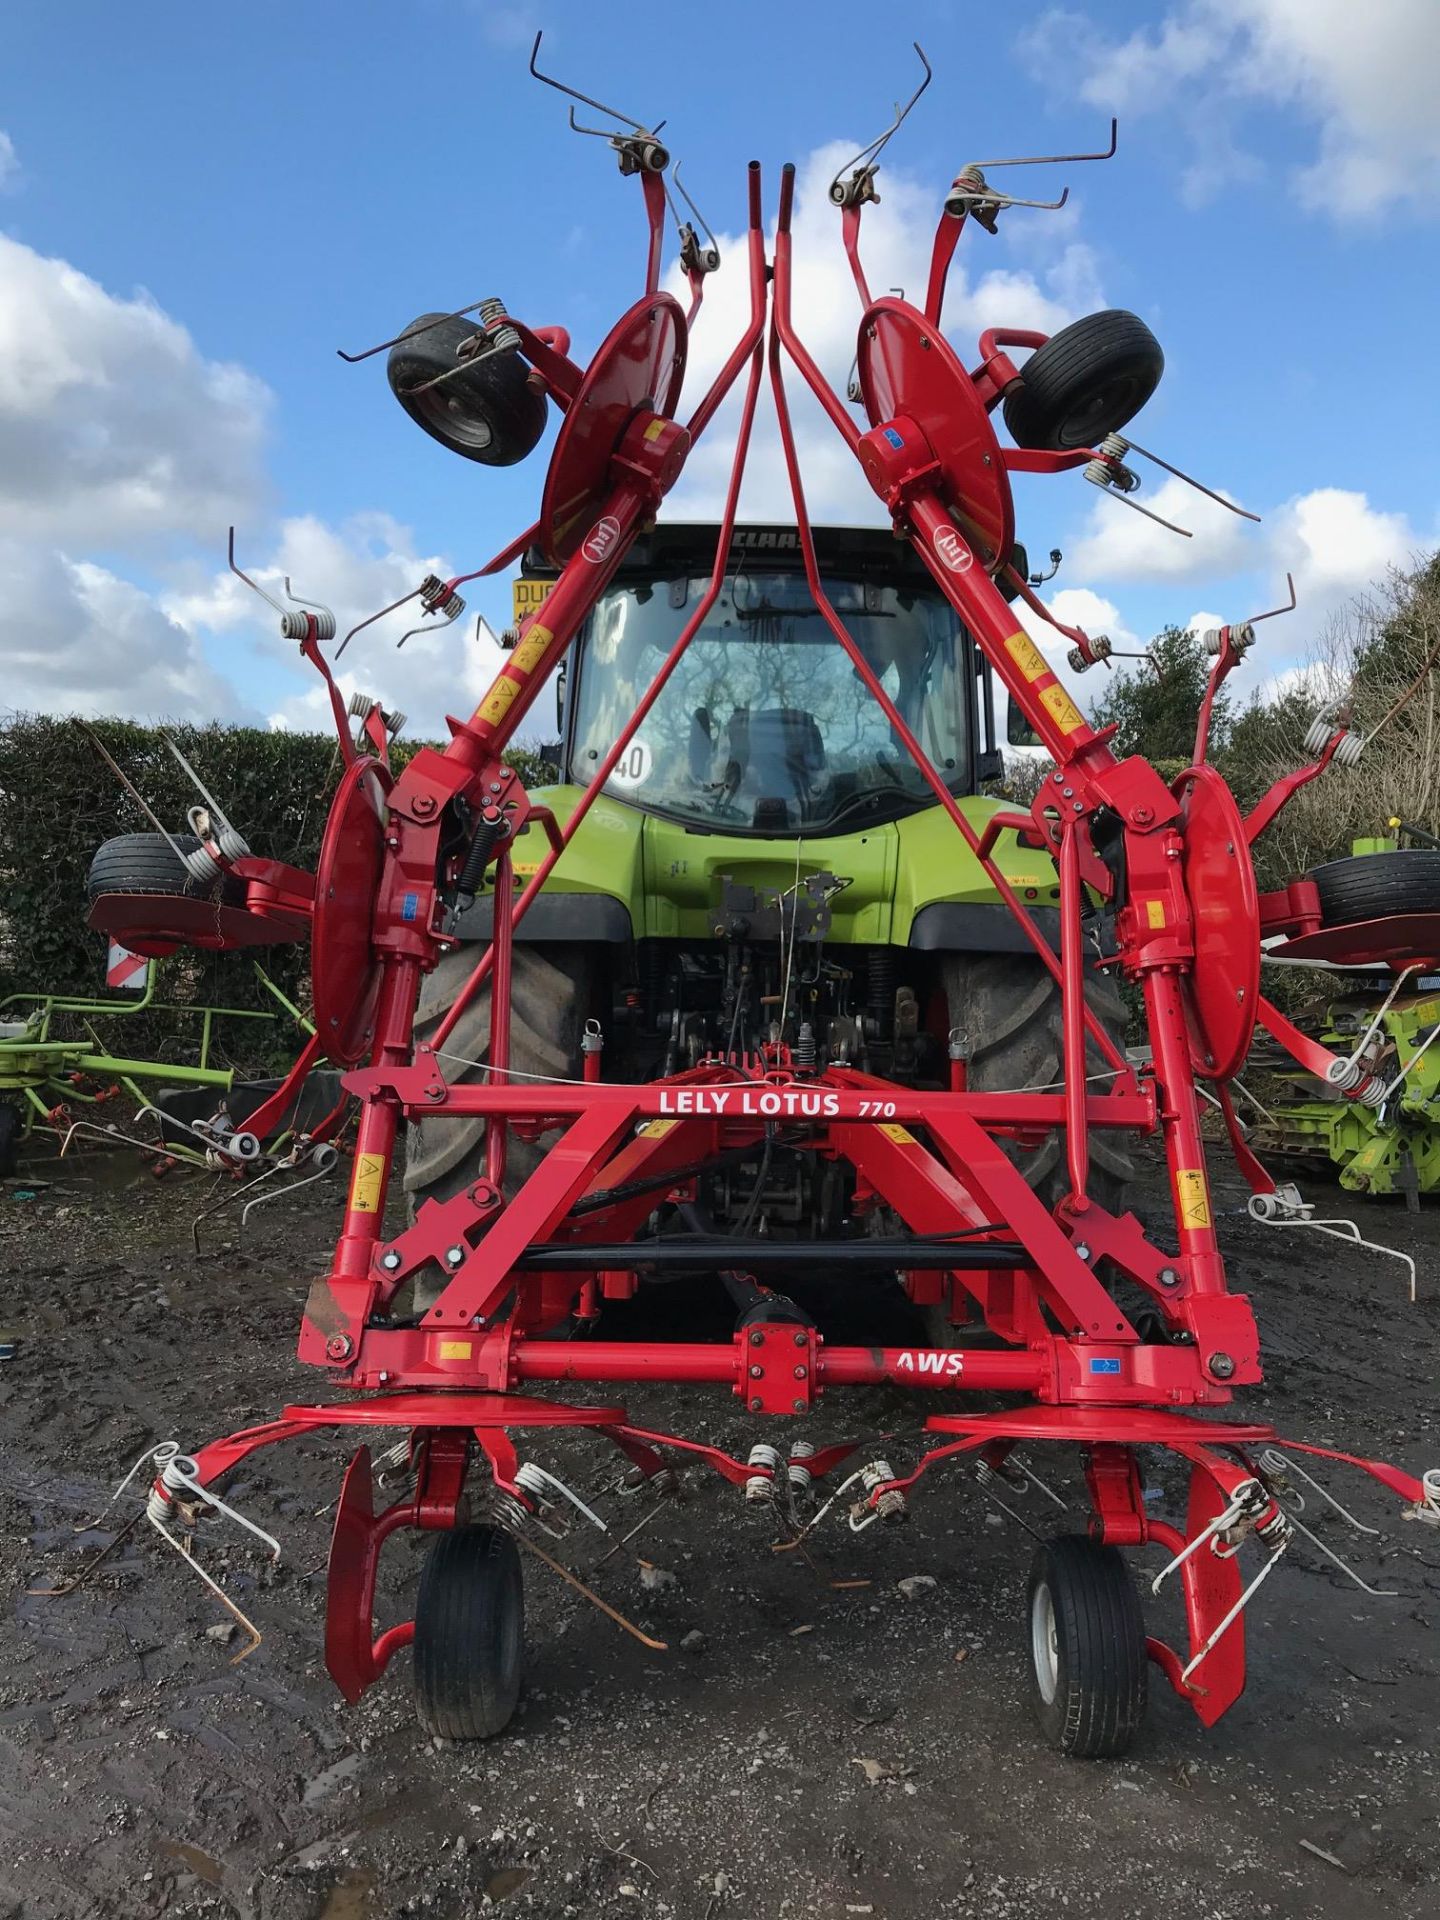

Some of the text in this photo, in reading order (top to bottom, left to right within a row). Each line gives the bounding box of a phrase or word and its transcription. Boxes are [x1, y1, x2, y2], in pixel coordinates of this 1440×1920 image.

[614, 746, 643, 779] 40
[659, 1091, 896, 1118] LELY LOTUS 770
[896, 1351, 964, 1375] AWS
